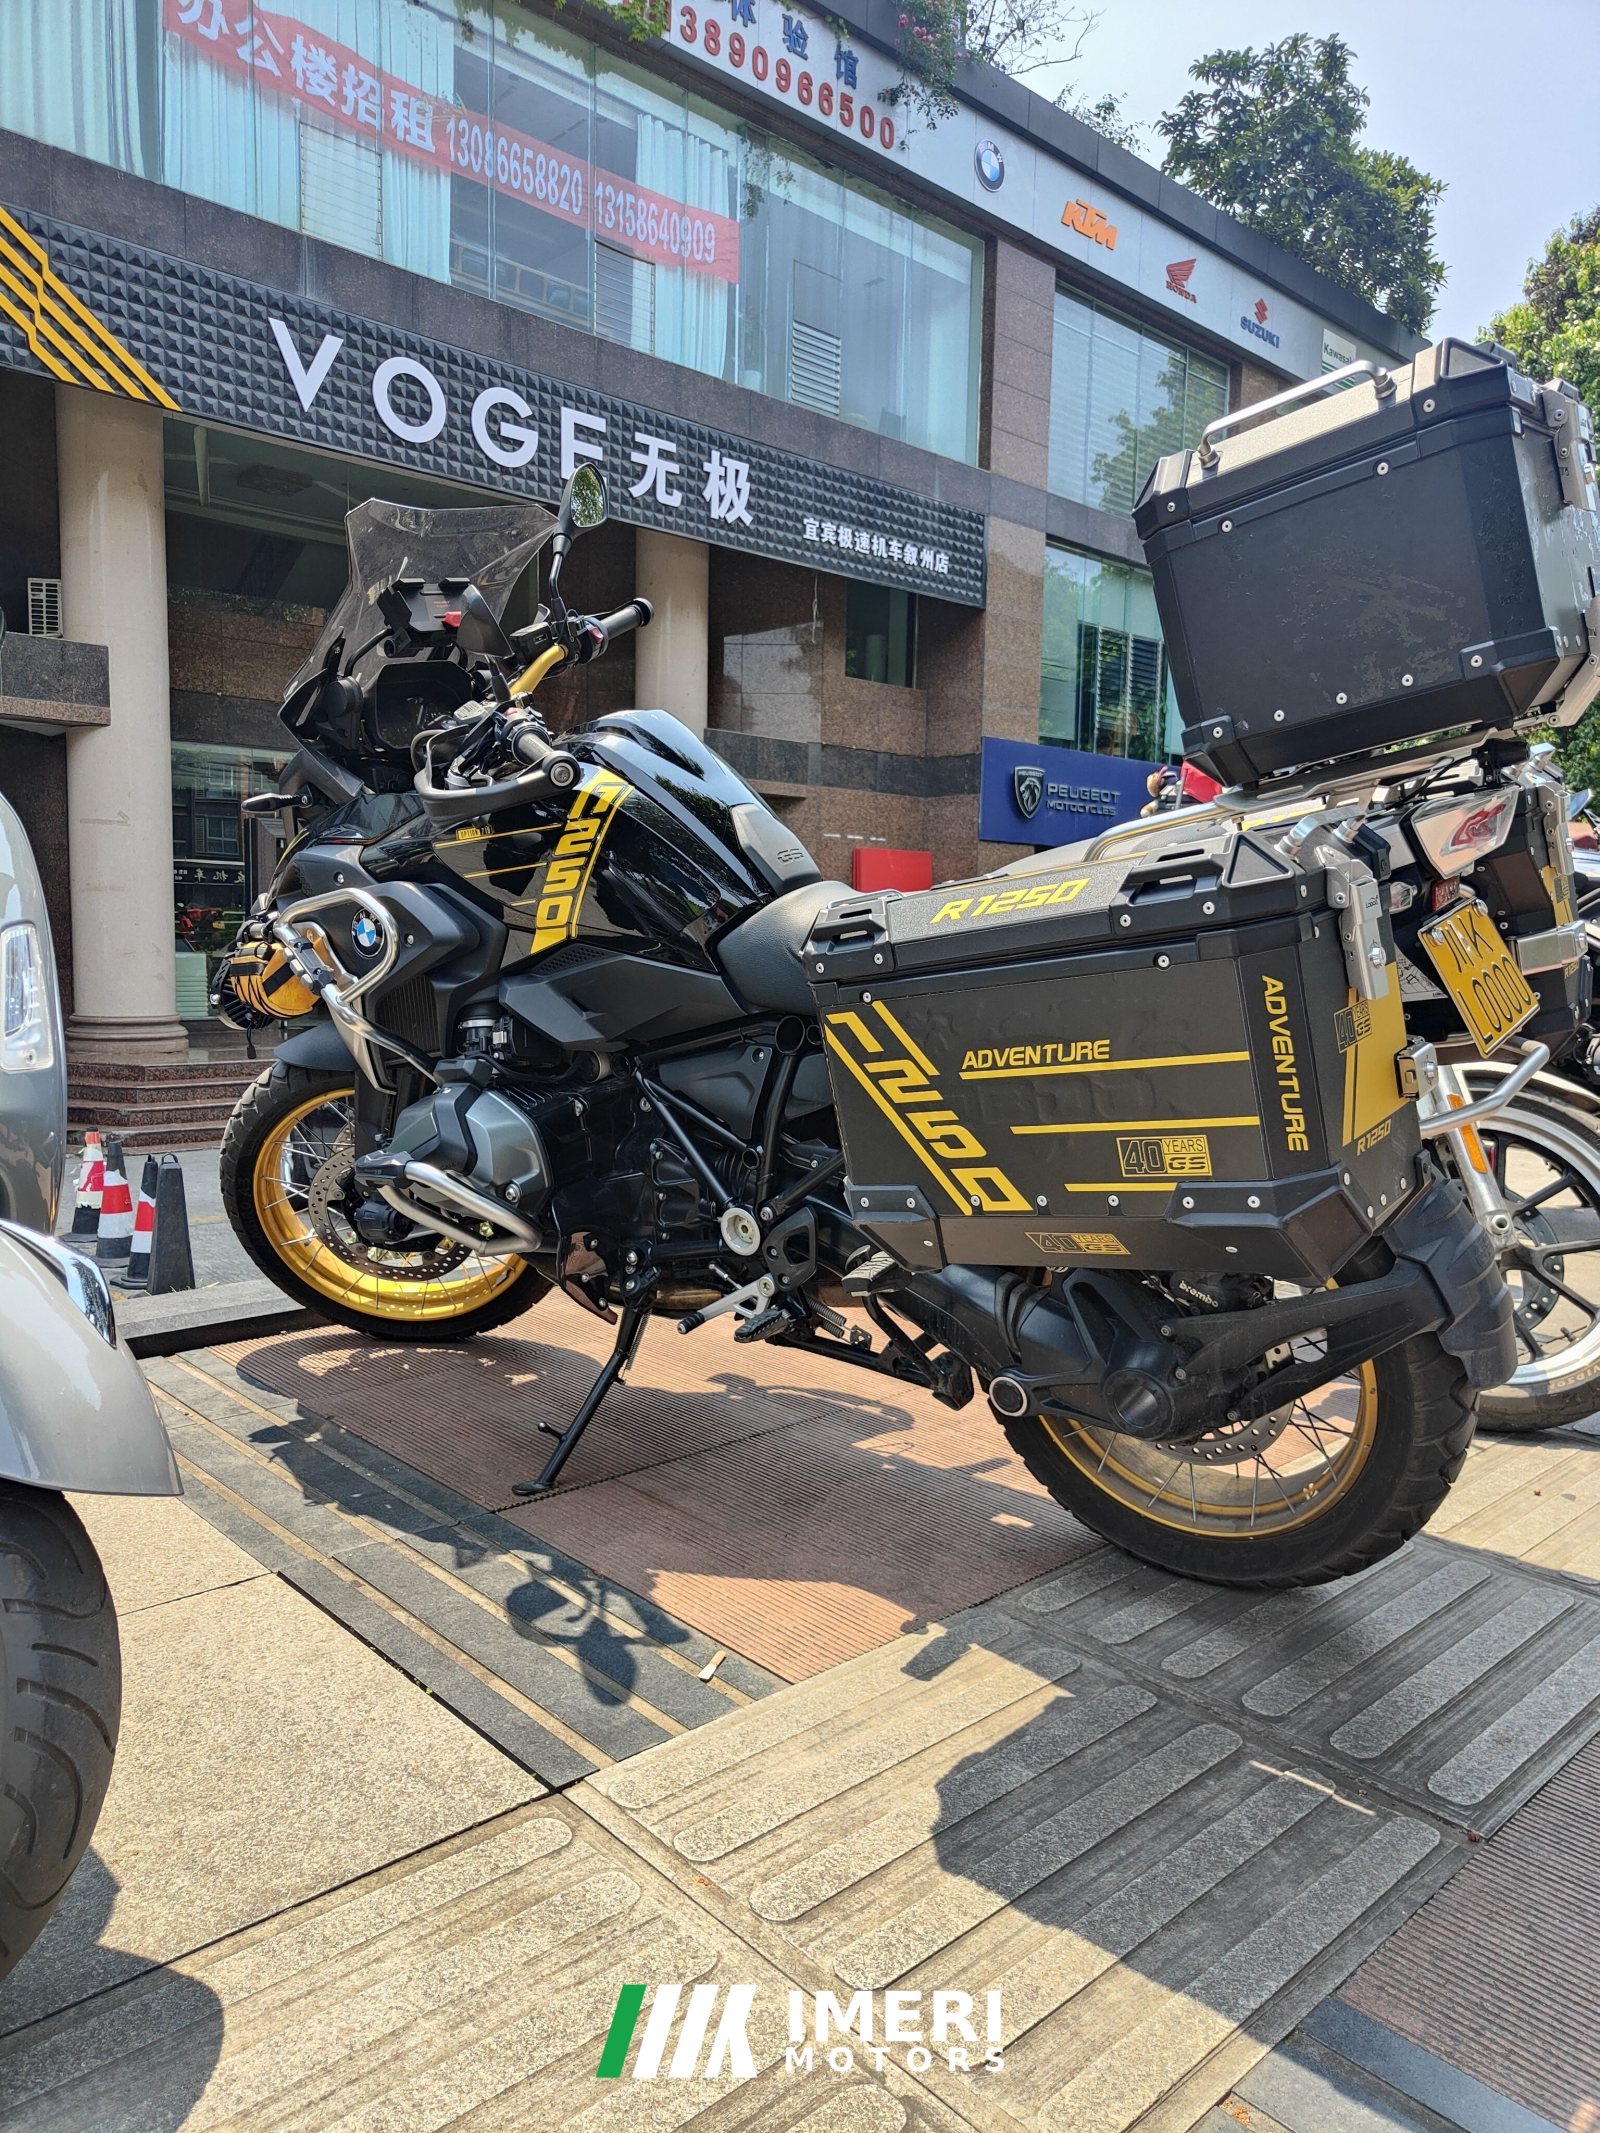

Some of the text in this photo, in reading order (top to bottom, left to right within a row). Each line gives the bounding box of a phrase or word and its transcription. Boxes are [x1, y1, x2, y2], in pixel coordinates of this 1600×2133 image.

[178, 0, 715, 263] 办公楼招租 13086658820 13158640909
[1061, 199, 1118, 251] KTM
[1166, 280, 1198, 304] HONDA
[1240, 315, 1280, 349] SUZUKI
[630, 431, 754, 527] 无极
[802, 518, 950, 574] 宜宾极速机车叙州店
[1047, 783, 1121, 803] PEUGEOT
[1047, 800, 1117, 816] MOTOCYCLES
[930, 878, 1092, 924] R1250
[1356, 1018, 1371, 1037] GS
[961, 1039, 1111, 1070] ADVENTURE
[1261, 974, 1310, 1152] ADVENTURE
[1356, 1120, 1391, 1155] R1250
[1123, 1138, 1204, 1174] 40 YEARS
[1168, 1156, 1206, 1170] GS
[1040, 1233, 1114, 1253] 40 YEARS
[1178, 1280, 1219, 1308] brembo
